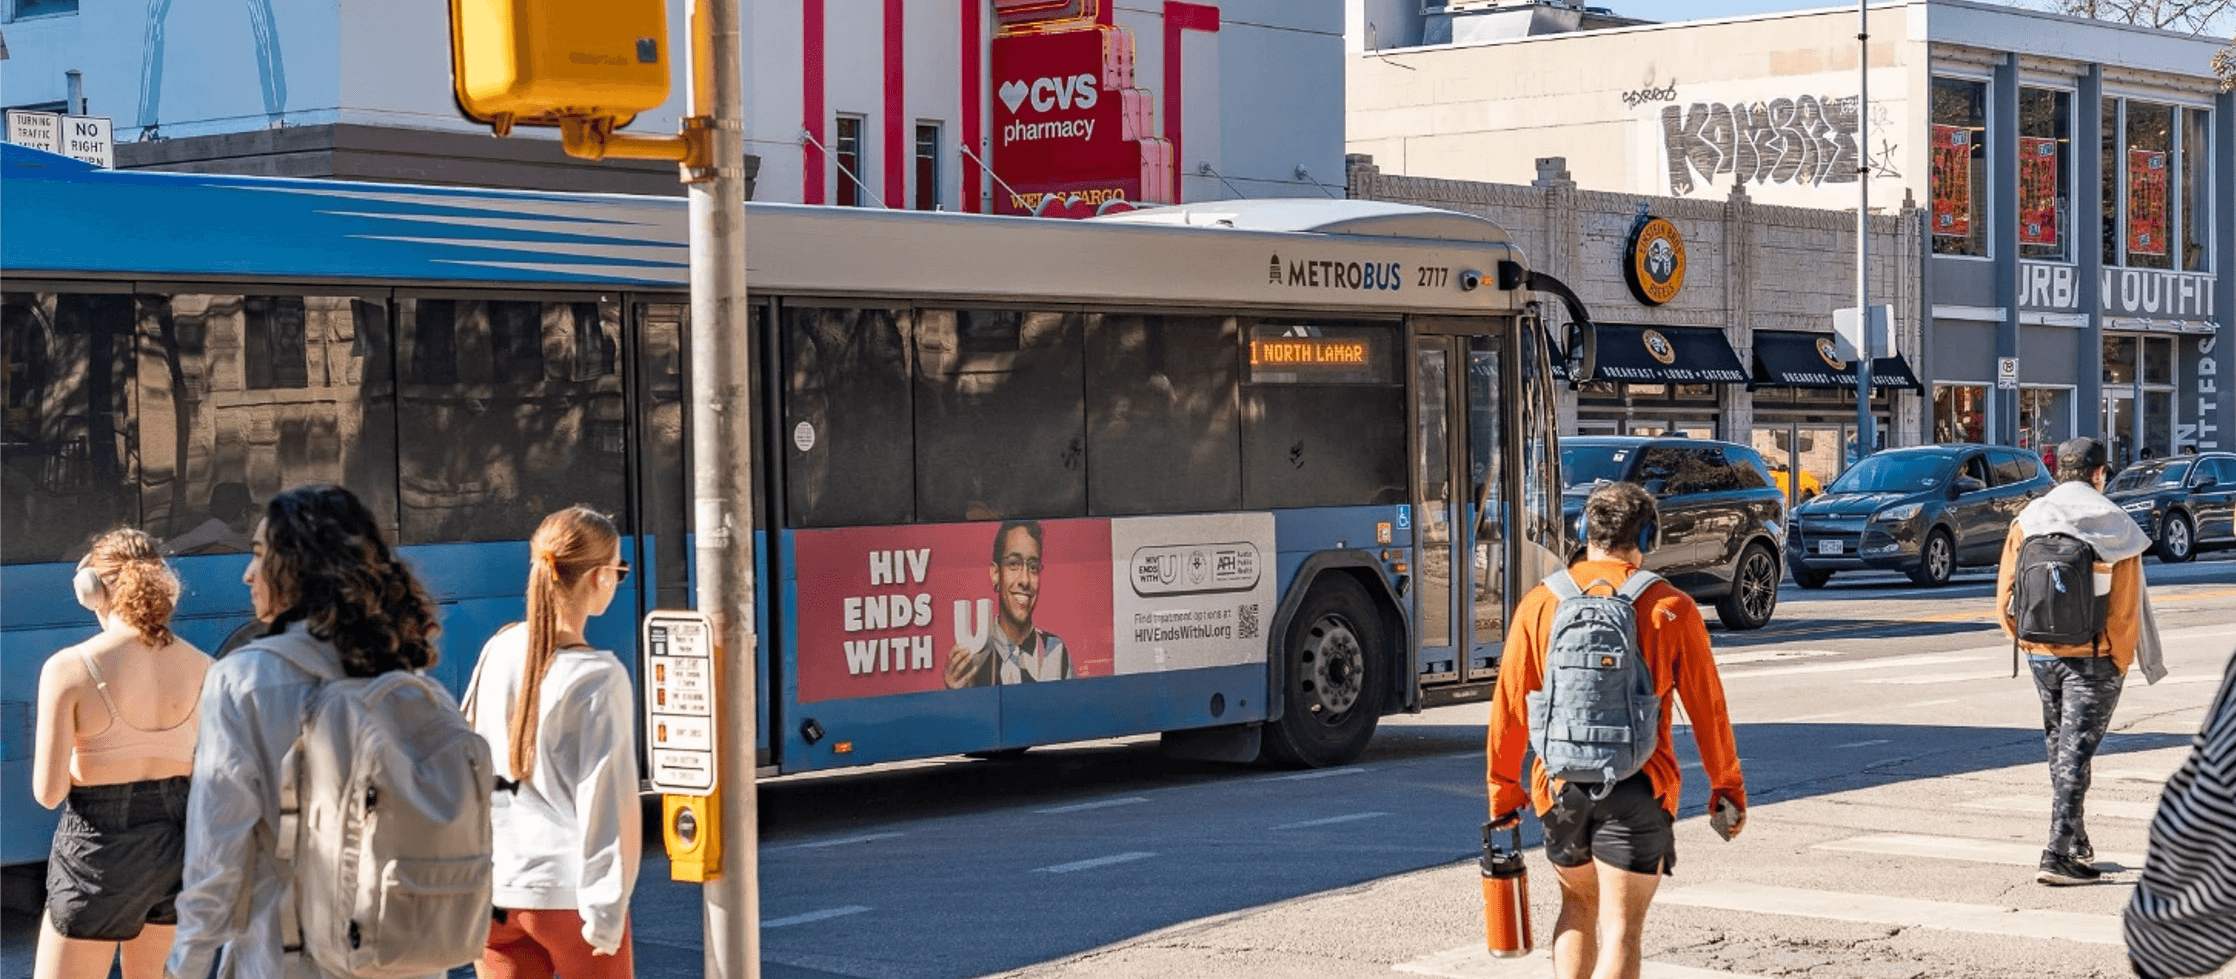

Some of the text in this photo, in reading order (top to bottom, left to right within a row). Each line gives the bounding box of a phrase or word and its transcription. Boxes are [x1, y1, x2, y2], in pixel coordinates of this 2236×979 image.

[1031, 73, 1098, 113] CVS
[17, 115, 51, 126] TURNING
[76, 122, 98, 137] NO
[18, 128, 50, 139] TRAFFIC
[1004, 118, 1095, 147] pharmacy
[18, 142, 50, 151] ST
[71, 140, 104, 153] RIGHT
[73, 156, 104, 166] RN
[1009, 192, 1067, 210] WELS
[1288, 259, 1449, 291] METROBUS 2717
[1250, 340, 1365, 364] 1 NORTH LAMAR
[1663, 368, 1695, 380] LUNCH
[1836, 374, 1859, 384] LUNC
[869, 548, 931, 585] HIV
[1139, 565, 1158, 574] ENDS
[1140, 574, 1159, 583] WITH
[1158, 555, 1177, 585] U
[844, 593, 933, 632] ENDS
[1134, 613, 1152, 624] Find
[1193, 610, 1222, 623] options
[1223, 609, 1232, 619] at
[954, 598, 993, 653] U
[1134, 625, 1232, 643] HIVEndsWithU.org
[844, 635, 933, 676] WITH
